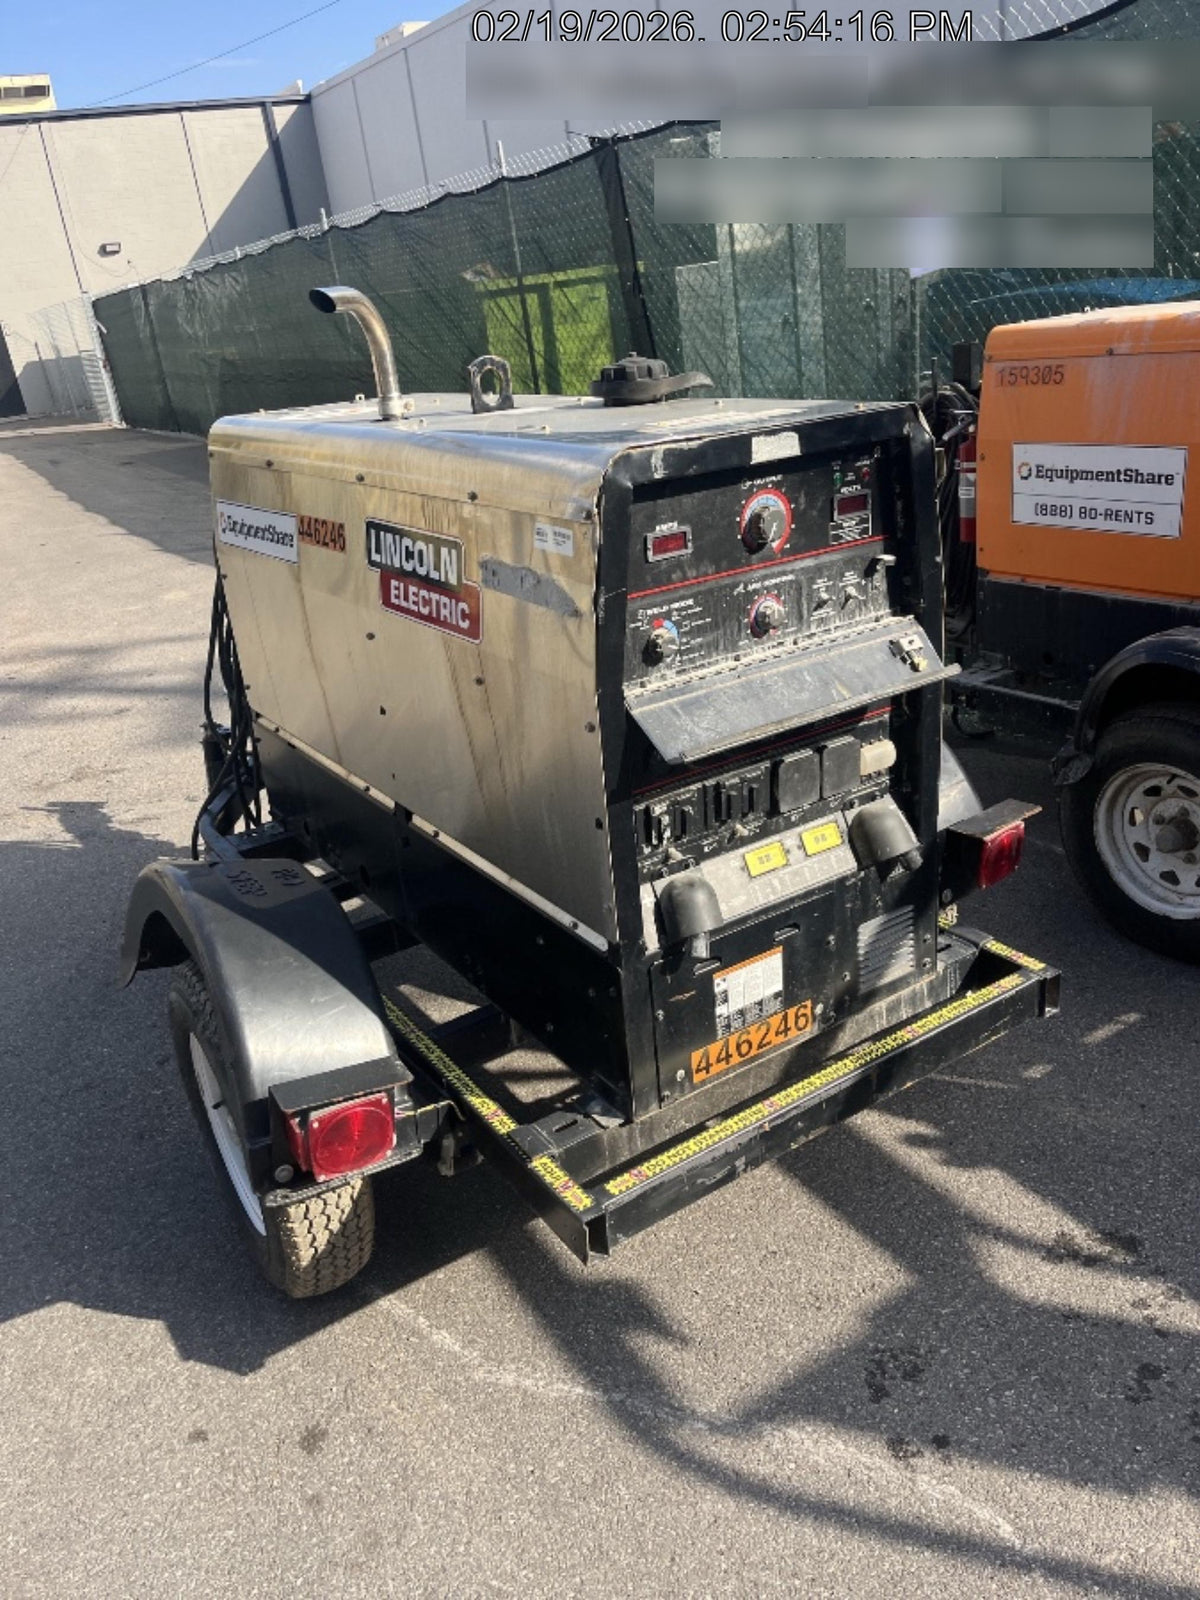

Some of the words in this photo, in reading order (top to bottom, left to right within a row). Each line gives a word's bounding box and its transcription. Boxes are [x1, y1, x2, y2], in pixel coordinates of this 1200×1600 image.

[997, 364, 1065, 387] 159305
[1034, 463, 1175, 487] EquipmentShare
[227, 514, 294, 548] EquipmentShare
[1034, 503, 1073, 520] (888)
[1078, 506, 1155, 526] 80-RENTS
[298, 514, 346, 552] 446246
[369, 528, 458, 585] LINCOLN
[389, 579, 470, 629] ELECTRIC
[694, 1004, 810, 1075] 446246
